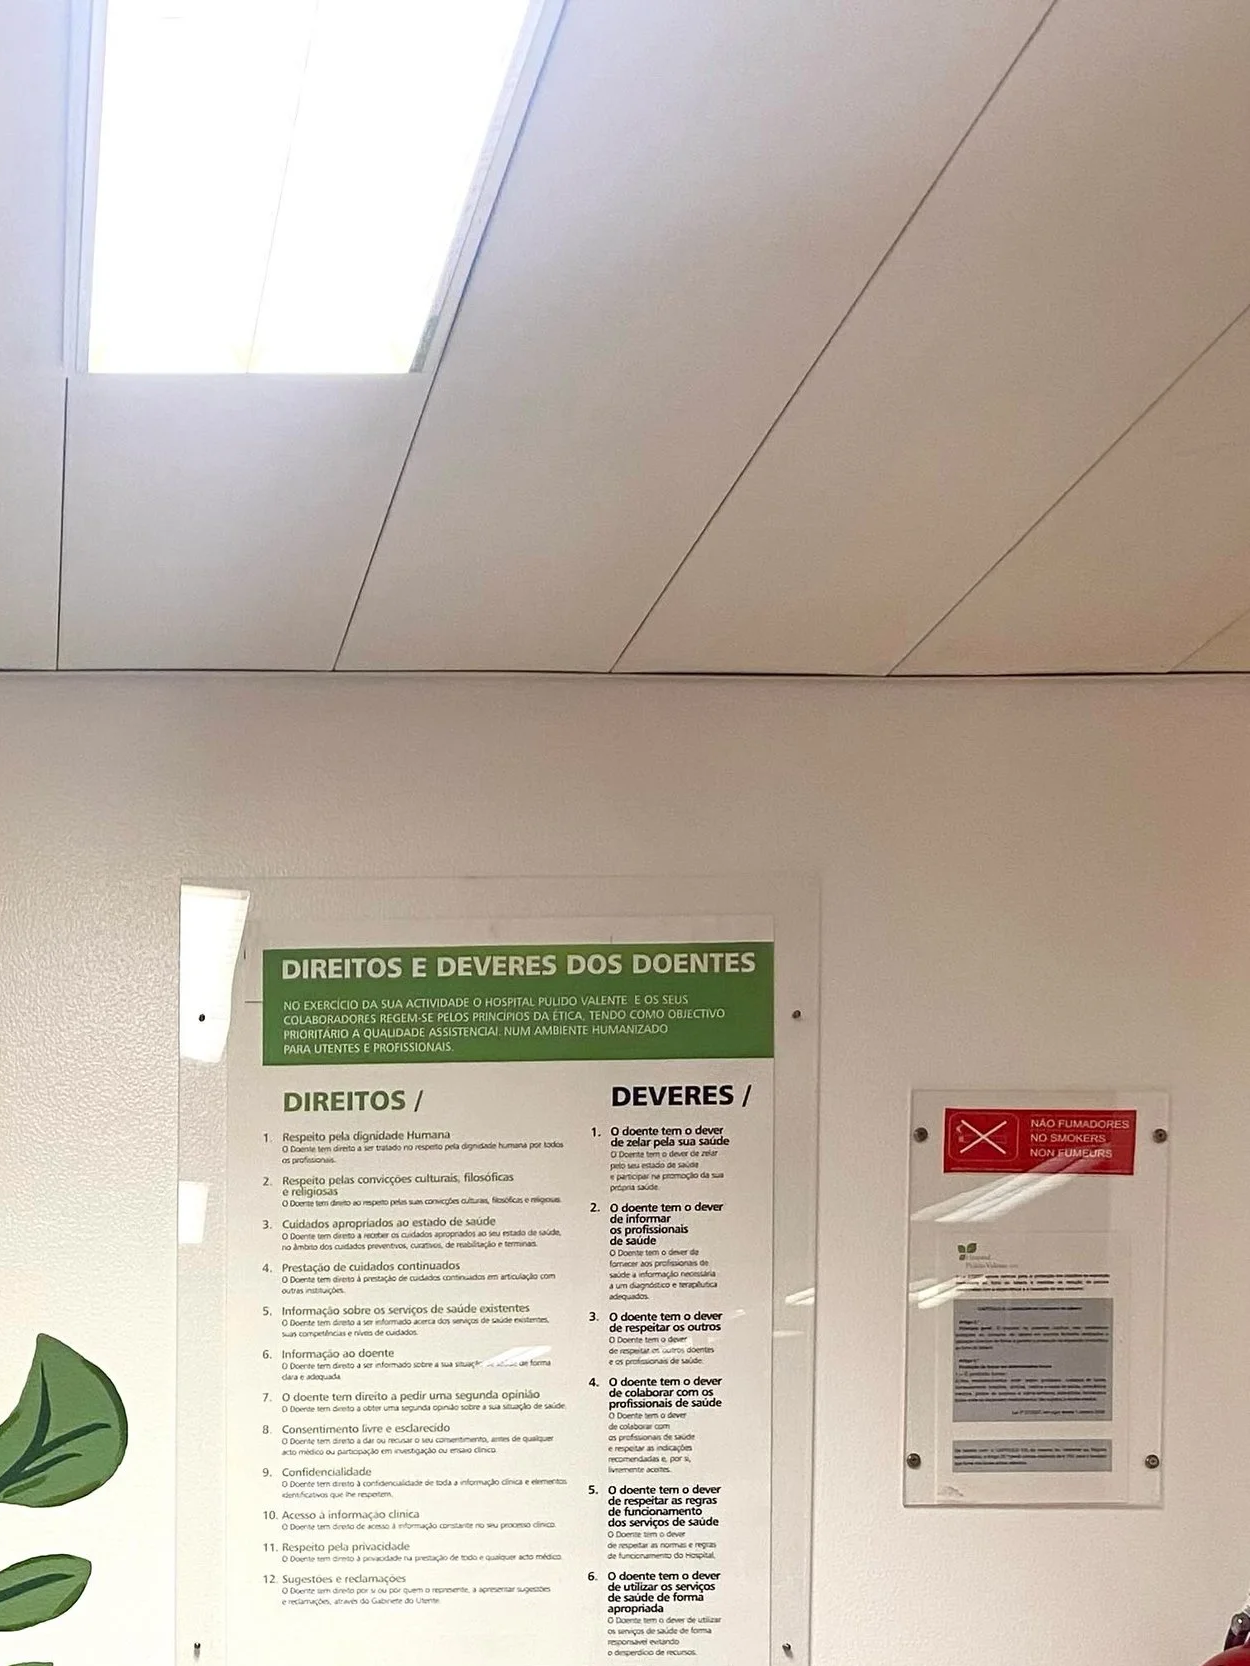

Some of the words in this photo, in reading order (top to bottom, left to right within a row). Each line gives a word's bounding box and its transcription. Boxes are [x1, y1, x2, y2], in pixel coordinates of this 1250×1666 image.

[281, 957, 402, 979] DIREITOS
[411, 957, 427, 977] E
[437, 955, 557, 976] DEVERES
[566, 954, 622, 975] DOS
[632, 953, 755, 974] DOENTES
[283, 1000, 300, 1010] NO
[303, 997, 358, 1010] EXERCÍCIO
[361, 999, 378, 1009] DA
[381, 999, 403, 1009] SUA
[405, 998, 469, 1008] ACTIVIDADE
[472, 997, 482, 1007] O
[484, 997, 535, 1007] HOSPITAL
[537, 996, 577, 1007] PULIDO
[580, 996, 627, 1006] VALENTE
[634, 995, 641, 1005] E
[643, 995, 659, 1005] OS
[662, 995, 688, 1005] SEUS
[283, 1013, 376, 1024] COLABORADORES
[379, 1012, 434, 1023] REGEM-SE
[436, 1012, 469, 1022] PELOS
[472, 1009, 530, 1022] PRINCÍPIOS
[533, 1011, 550, 1021] DA
[588, 1010, 626, 1020] TENDO
[629, 1010, 664, 1020] COMO
[667, 1009, 725, 1019] OBJECTIVO
[283, 1026, 349, 1039] PRIORITÁRIO
[351, 1028, 360, 1038] A
[363, 1027, 425, 1038] QUALIDADE
[503, 1026, 530, 1036] NUM
[533, 1025, 588, 1036] AMBIENTE
[591, 1024, 668, 1035] HUMANIZADO
[283, 1043, 311, 1054] PARA
[314, 1043, 360, 1053] UTENTES
[363, 1043, 370, 1053] E
[373, 1042, 454, 1053] PROFISSIONAIS.
[283, 1090, 406, 1112] DIREITOS
[414, 1090, 423, 1112] /
[611, 1084, 734, 1106] DEVERES
[742, 1084, 751, 1107] /
[1031, 1118, 1055, 1128] NÃO
[1058, 1119, 1130, 1129] FUMADORES
[282, 1130, 326, 1143] Respeito
[328, 1130, 350, 1143] pela
[352, 1129, 404, 1142] dignidade
[406, 1129, 450, 1140] Humana
[610, 1127, 619, 1136] O
[621, 1126, 659, 1136] doente
[660, 1126, 682, 1136] tem
[694, 1125, 723, 1135] dever
[610, 1137, 624, 1147] de
[626, 1137, 651, 1147] zelar
[653, 1137, 675, 1148] pela
[677, 1138, 696, 1146] sua
[698, 1136, 730, 1146] saúde
[1030, 1133, 1048, 1143] NO
[1050, 1134, 1106, 1143] SMOKERS
[1030, 1148, 1054, 1157] NON
[1057, 1149, 1113, 1158] FUMEURS
[282, 1174, 325, 1186] Respeito
[328, 1173, 355, 1186] pelas
[357, 1173, 412, 1186] convicções
[414, 1172, 460, 1185] culturais,
[463, 1172, 514, 1183] filosóficas
[281, 1188, 289, 1196] e
[291, 1185, 338, 1198] religiosas
[609, 1203, 618, 1212] O
[621, 1203, 658, 1212] doente
[660, 1202, 681, 1212] tem
[684, 1204, 691, 1212] o
[694, 1202, 723, 1212] dever
[281, 1217, 329, 1228] Cuidados
[332, 1217, 393, 1230] apropriados
[396, 1219, 409, 1227] ao
[411, 1216, 446, 1227] estado
[448, 1216, 463, 1227] de
[465, 1216, 496, 1226] saúde
[609, 1214, 623, 1224] de
[625, 1214, 671, 1224] informar
[624, 1224, 688, 1236] profissionais
[609, 1236, 623, 1246] de
[625, 1236, 656, 1245] saúde
[281, 1261, 330, 1274] Prestação
[332, 1261, 346, 1271] de
[348, 1260, 394, 1271] cuidados
[397, 1260, 460, 1271] continuados
[281, 1347, 340, 1360] Informação
[342, 1350, 355, 1358] ao
[358, 1347, 394, 1358] doente
[281, 1423, 359, 1434] Consentimento
[361, 1423, 383, 1433] livre
[385, 1425, 392, 1433] e
[394, 1422, 450, 1433] esclarecido
[281, 1466, 372, 1477] Confidencialidade
[607, 1485, 617, 1495] O
[619, 1485, 656, 1495] doente
[658, 1485, 679, 1494] tem
[691, 1485, 721, 1494] dever
[607, 1496, 621, 1506] de
[623, 1496, 669, 1507] respeitar
[670, 1497, 683, 1505] as
[685, 1497, 717, 1507] regras
[607, 1507, 621, 1516] de
[623, 1506, 703, 1516] funcionamento
[607, 1517, 627, 1527] dos
[628, 1517, 669, 1529] serviços
[671, 1517, 686, 1526] de
[687, 1517, 719, 1526] saúde
[281, 1541, 325, 1553] Respeito
[327, 1541, 349, 1553] pela
[351, 1540, 410, 1553] privacidade
[607, 1571, 616, 1581] O
[618, 1571, 656, 1581] doente
[658, 1571, 679, 1580] tem
[691, 1571, 721, 1580] dever
[607, 1582, 621, 1591] de
[623, 1582, 658, 1591] utilizar
[660, 1583, 672, 1591] os
[675, 1581, 715, 1593] serviços
[607, 1593, 621, 1602] de
[623, 1592, 654, 1602] saúde
[656, 1592, 670, 1602] de
[672, 1592, 704, 1602] forma
[607, 1603, 664, 1615] apropriada
